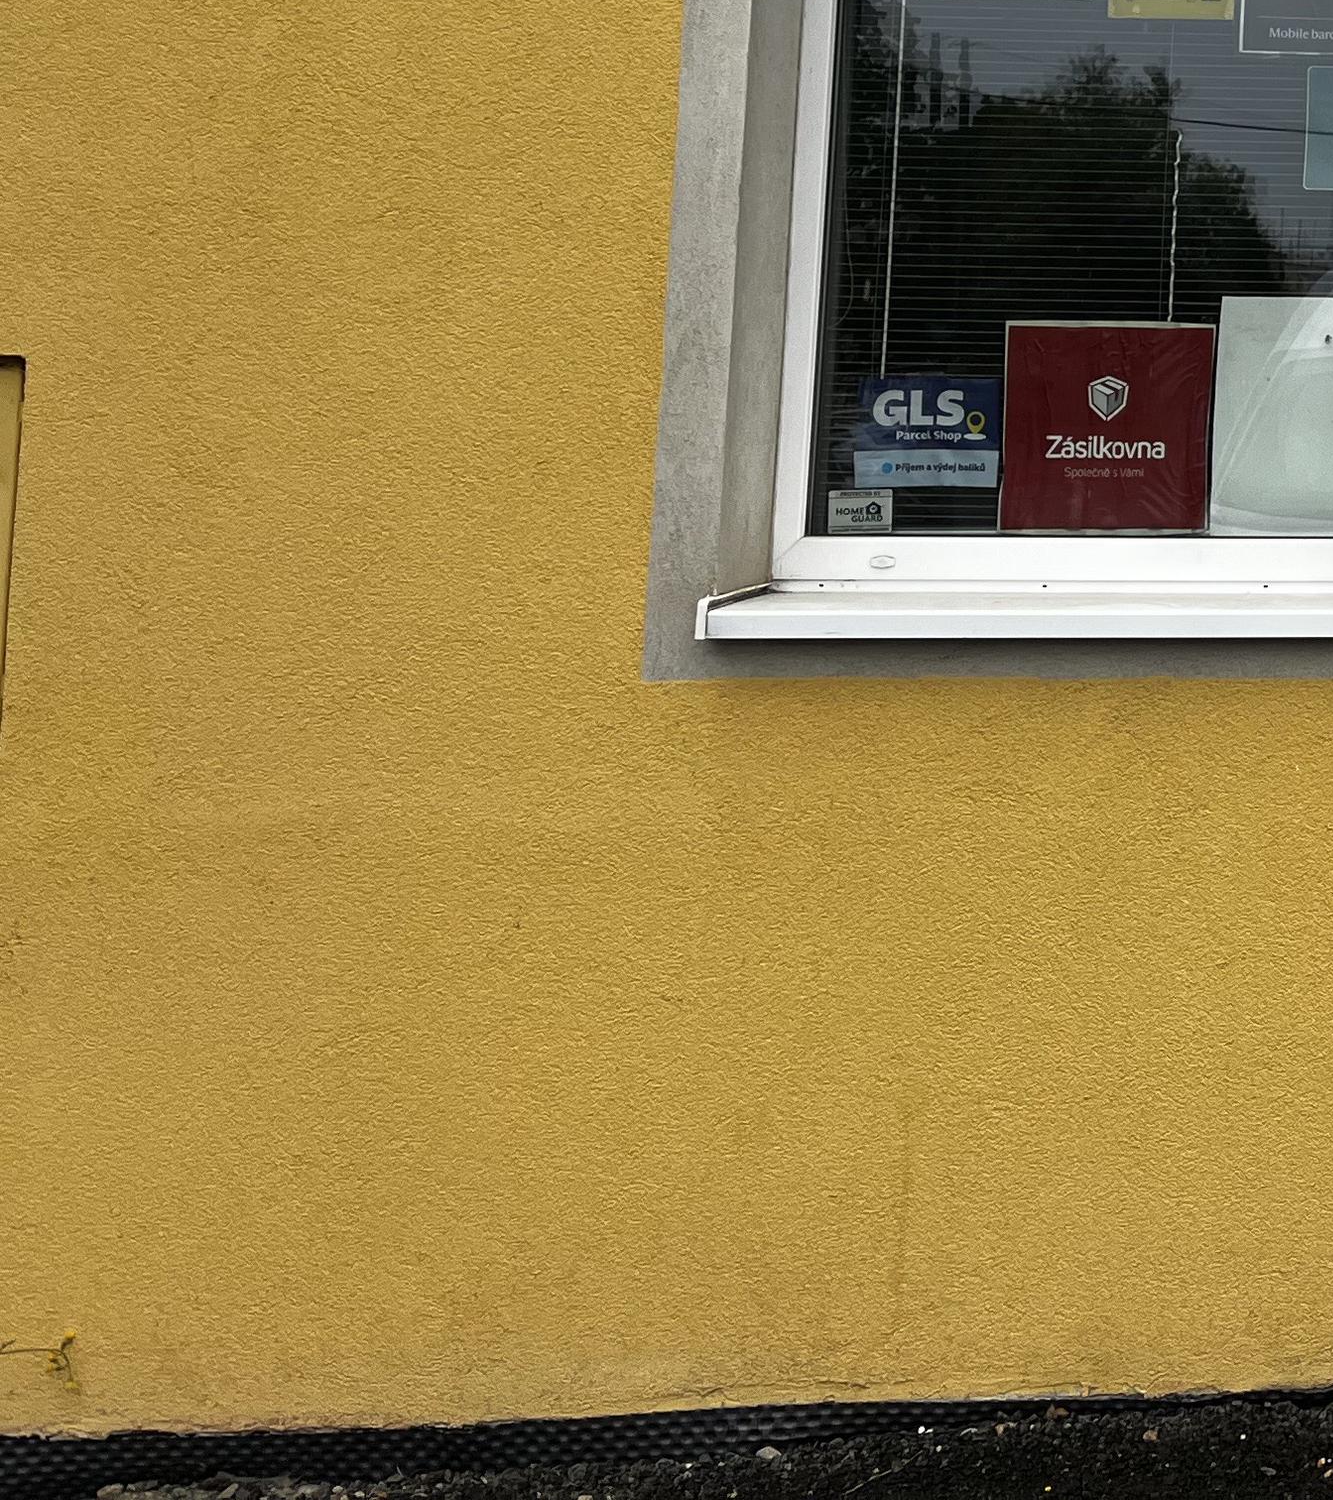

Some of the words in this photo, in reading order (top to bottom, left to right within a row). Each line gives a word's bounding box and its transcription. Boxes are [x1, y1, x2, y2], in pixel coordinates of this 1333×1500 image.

[1269, 27, 1308, 40] Mobile
[872, 389, 966, 427] GLS
[895, 430, 932, 440] Parcel
[933, 430, 962, 443] Shop
[1045, 435, 1166, 460] Zásilkovna
